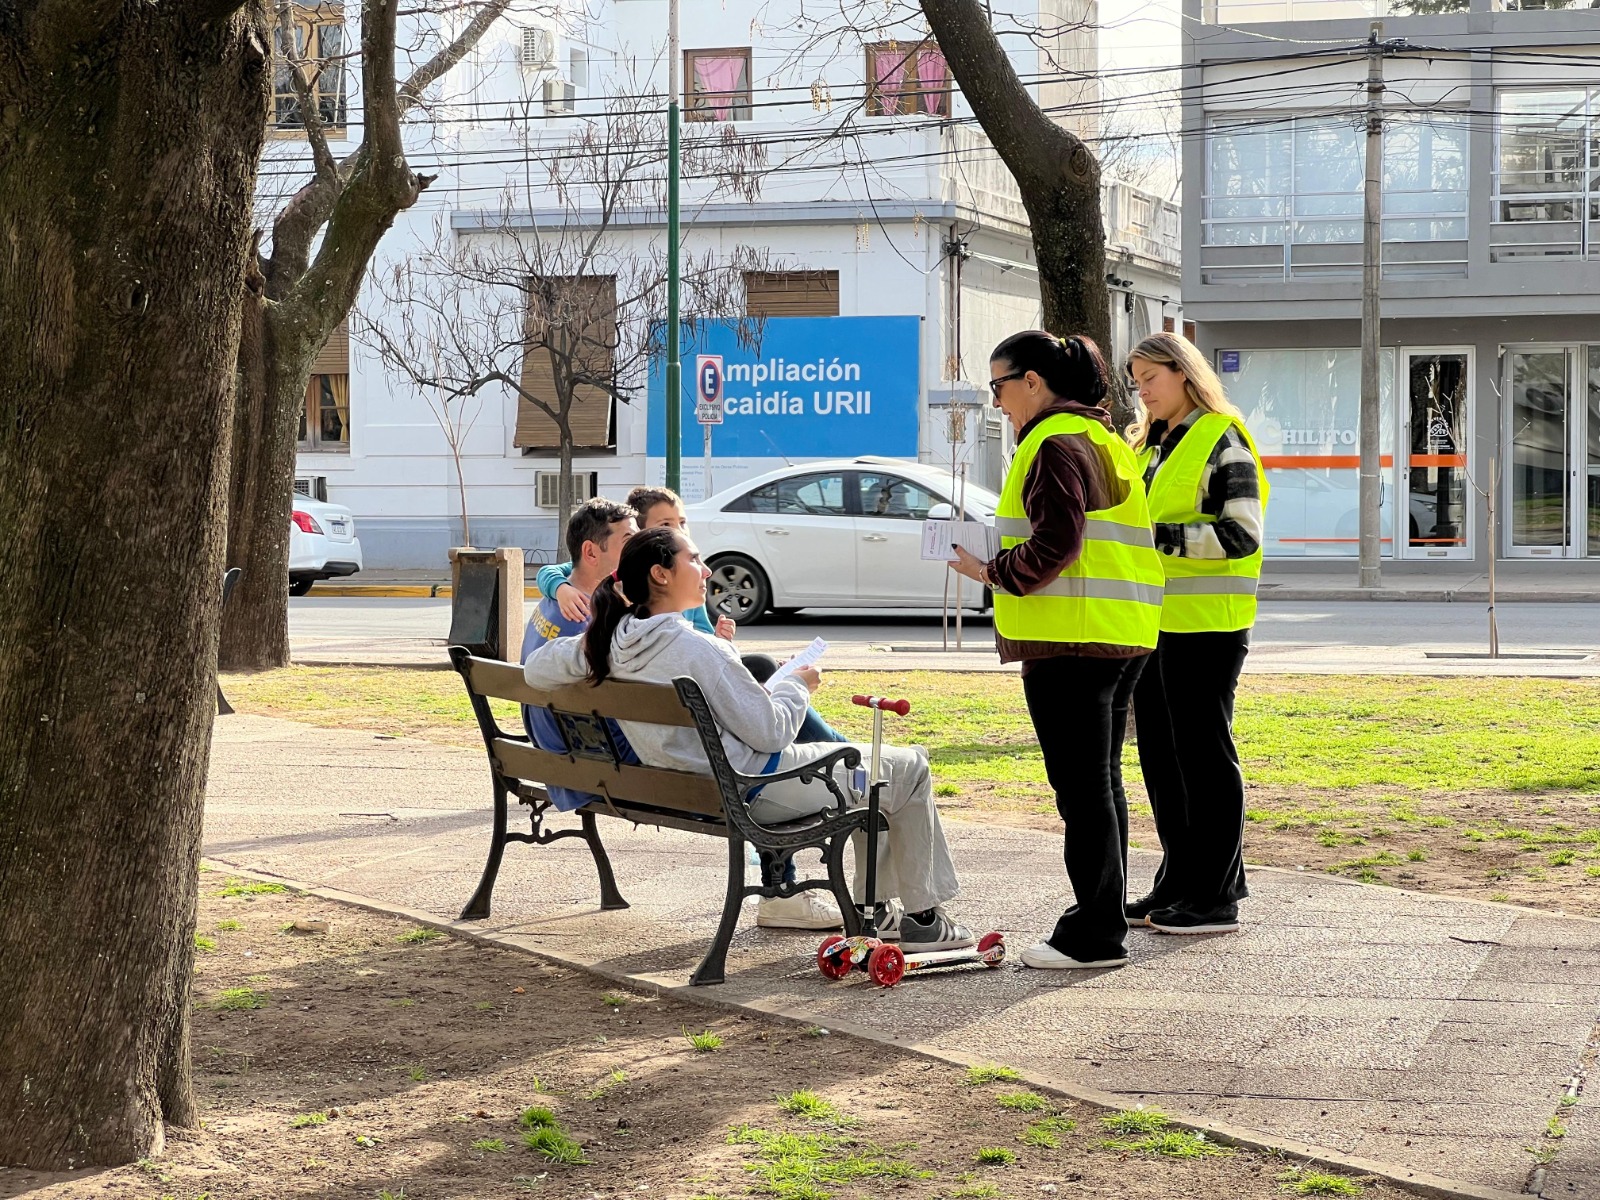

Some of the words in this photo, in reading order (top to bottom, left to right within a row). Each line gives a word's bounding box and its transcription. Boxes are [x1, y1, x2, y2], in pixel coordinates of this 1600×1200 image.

[705, 368, 715, 394] E
[694, 391, 804, 415] caidía
[813, 391, 871, 415] URII
